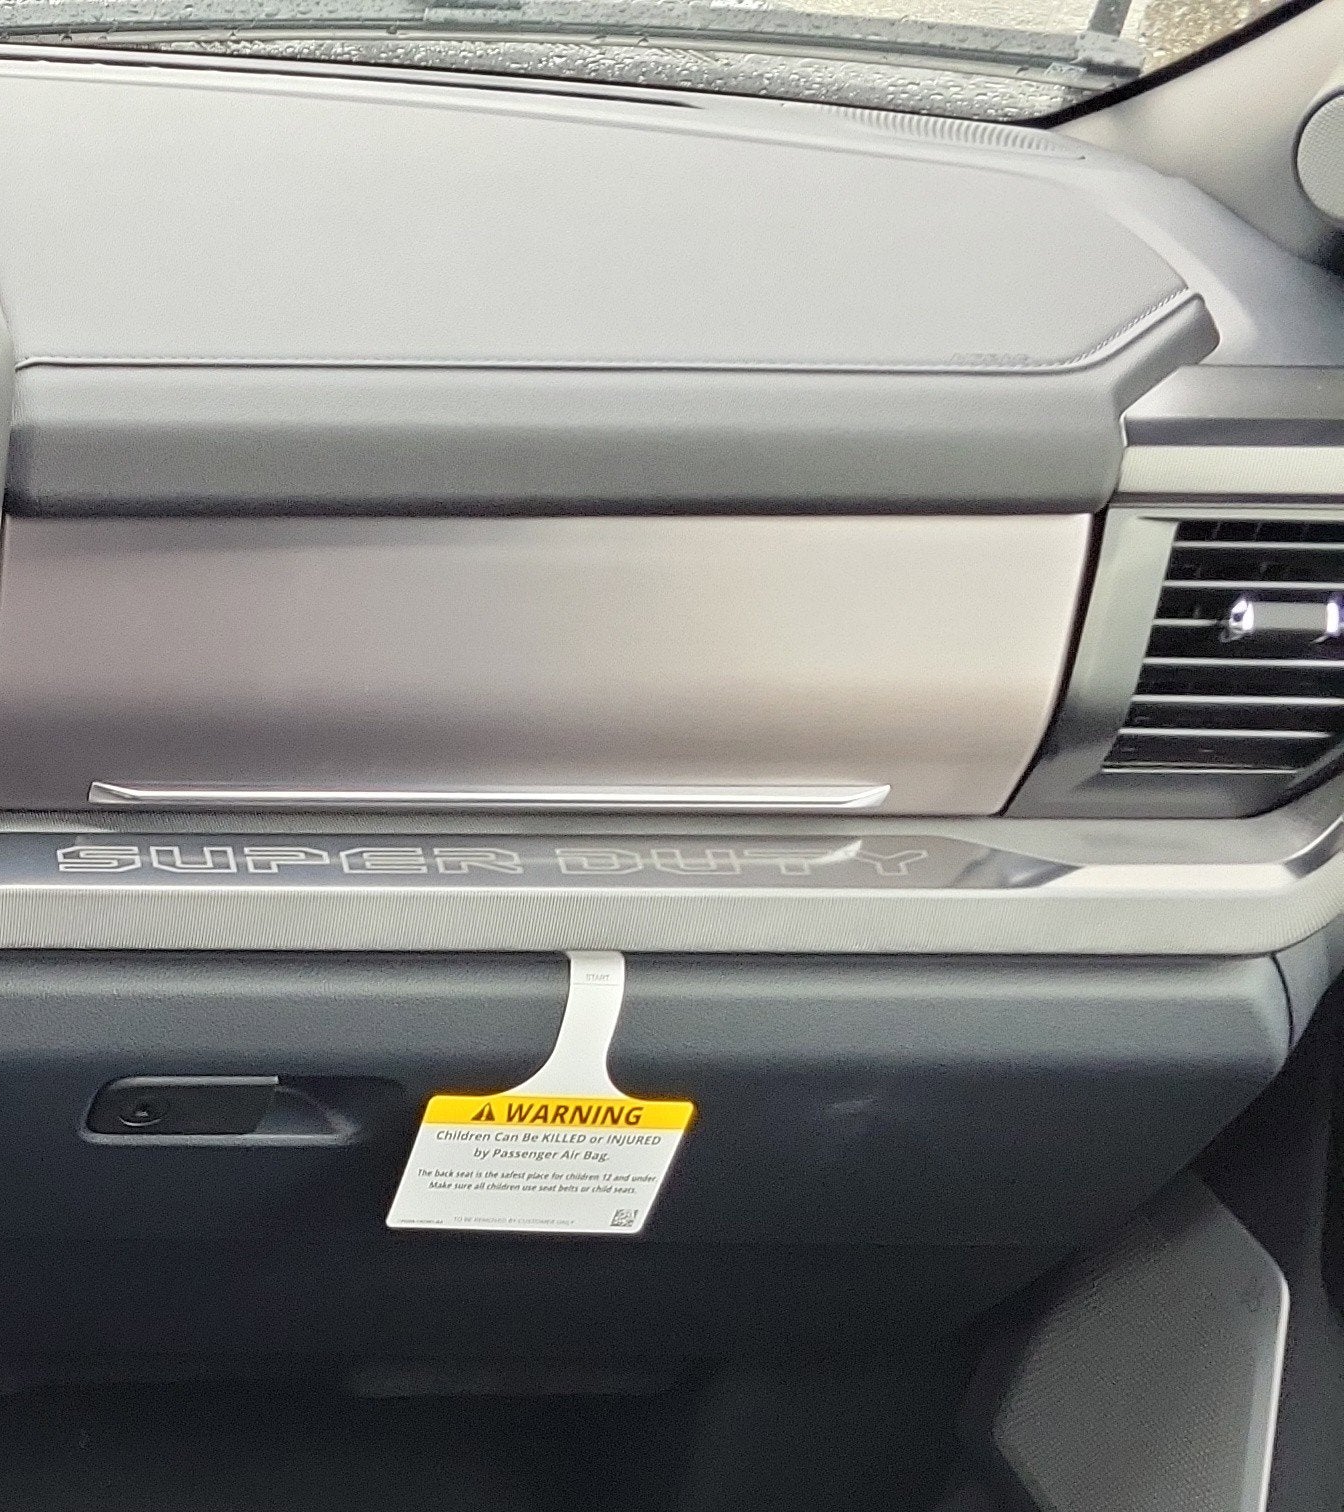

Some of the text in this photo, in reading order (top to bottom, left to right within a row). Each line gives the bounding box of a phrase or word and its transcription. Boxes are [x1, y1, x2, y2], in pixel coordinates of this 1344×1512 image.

[56, 844, 928, 878] SUPER DUTY
[505, 1102, 644, 1126] WARNING
[436, 1130, 662, 1147] Children Can Be KILLED or INJURED
[473, 1147, 609, 1163] by Passenger Air Bag.
[418, 1168, 433, 1177] The
[434, 1168, 454, 1177] back
[456, 1170, 473, 1178] seat
[475, 1170, 482, 1178] is
[484, 1171, 499, 1179] the
[526, 1172, 549, 1181] place
[551, 1172, 564, 1181] for
[565, 1172, 600, 1181] children
[613, 1173, 630, 1182] and
[429, 1181, 452, 1189] Make
[473, 1182, 485, 1190] all
[486, 1183, 521, 1191] children
[557, 1184, 578, 1192] belts
[591, 1185, 611, 1194] child
